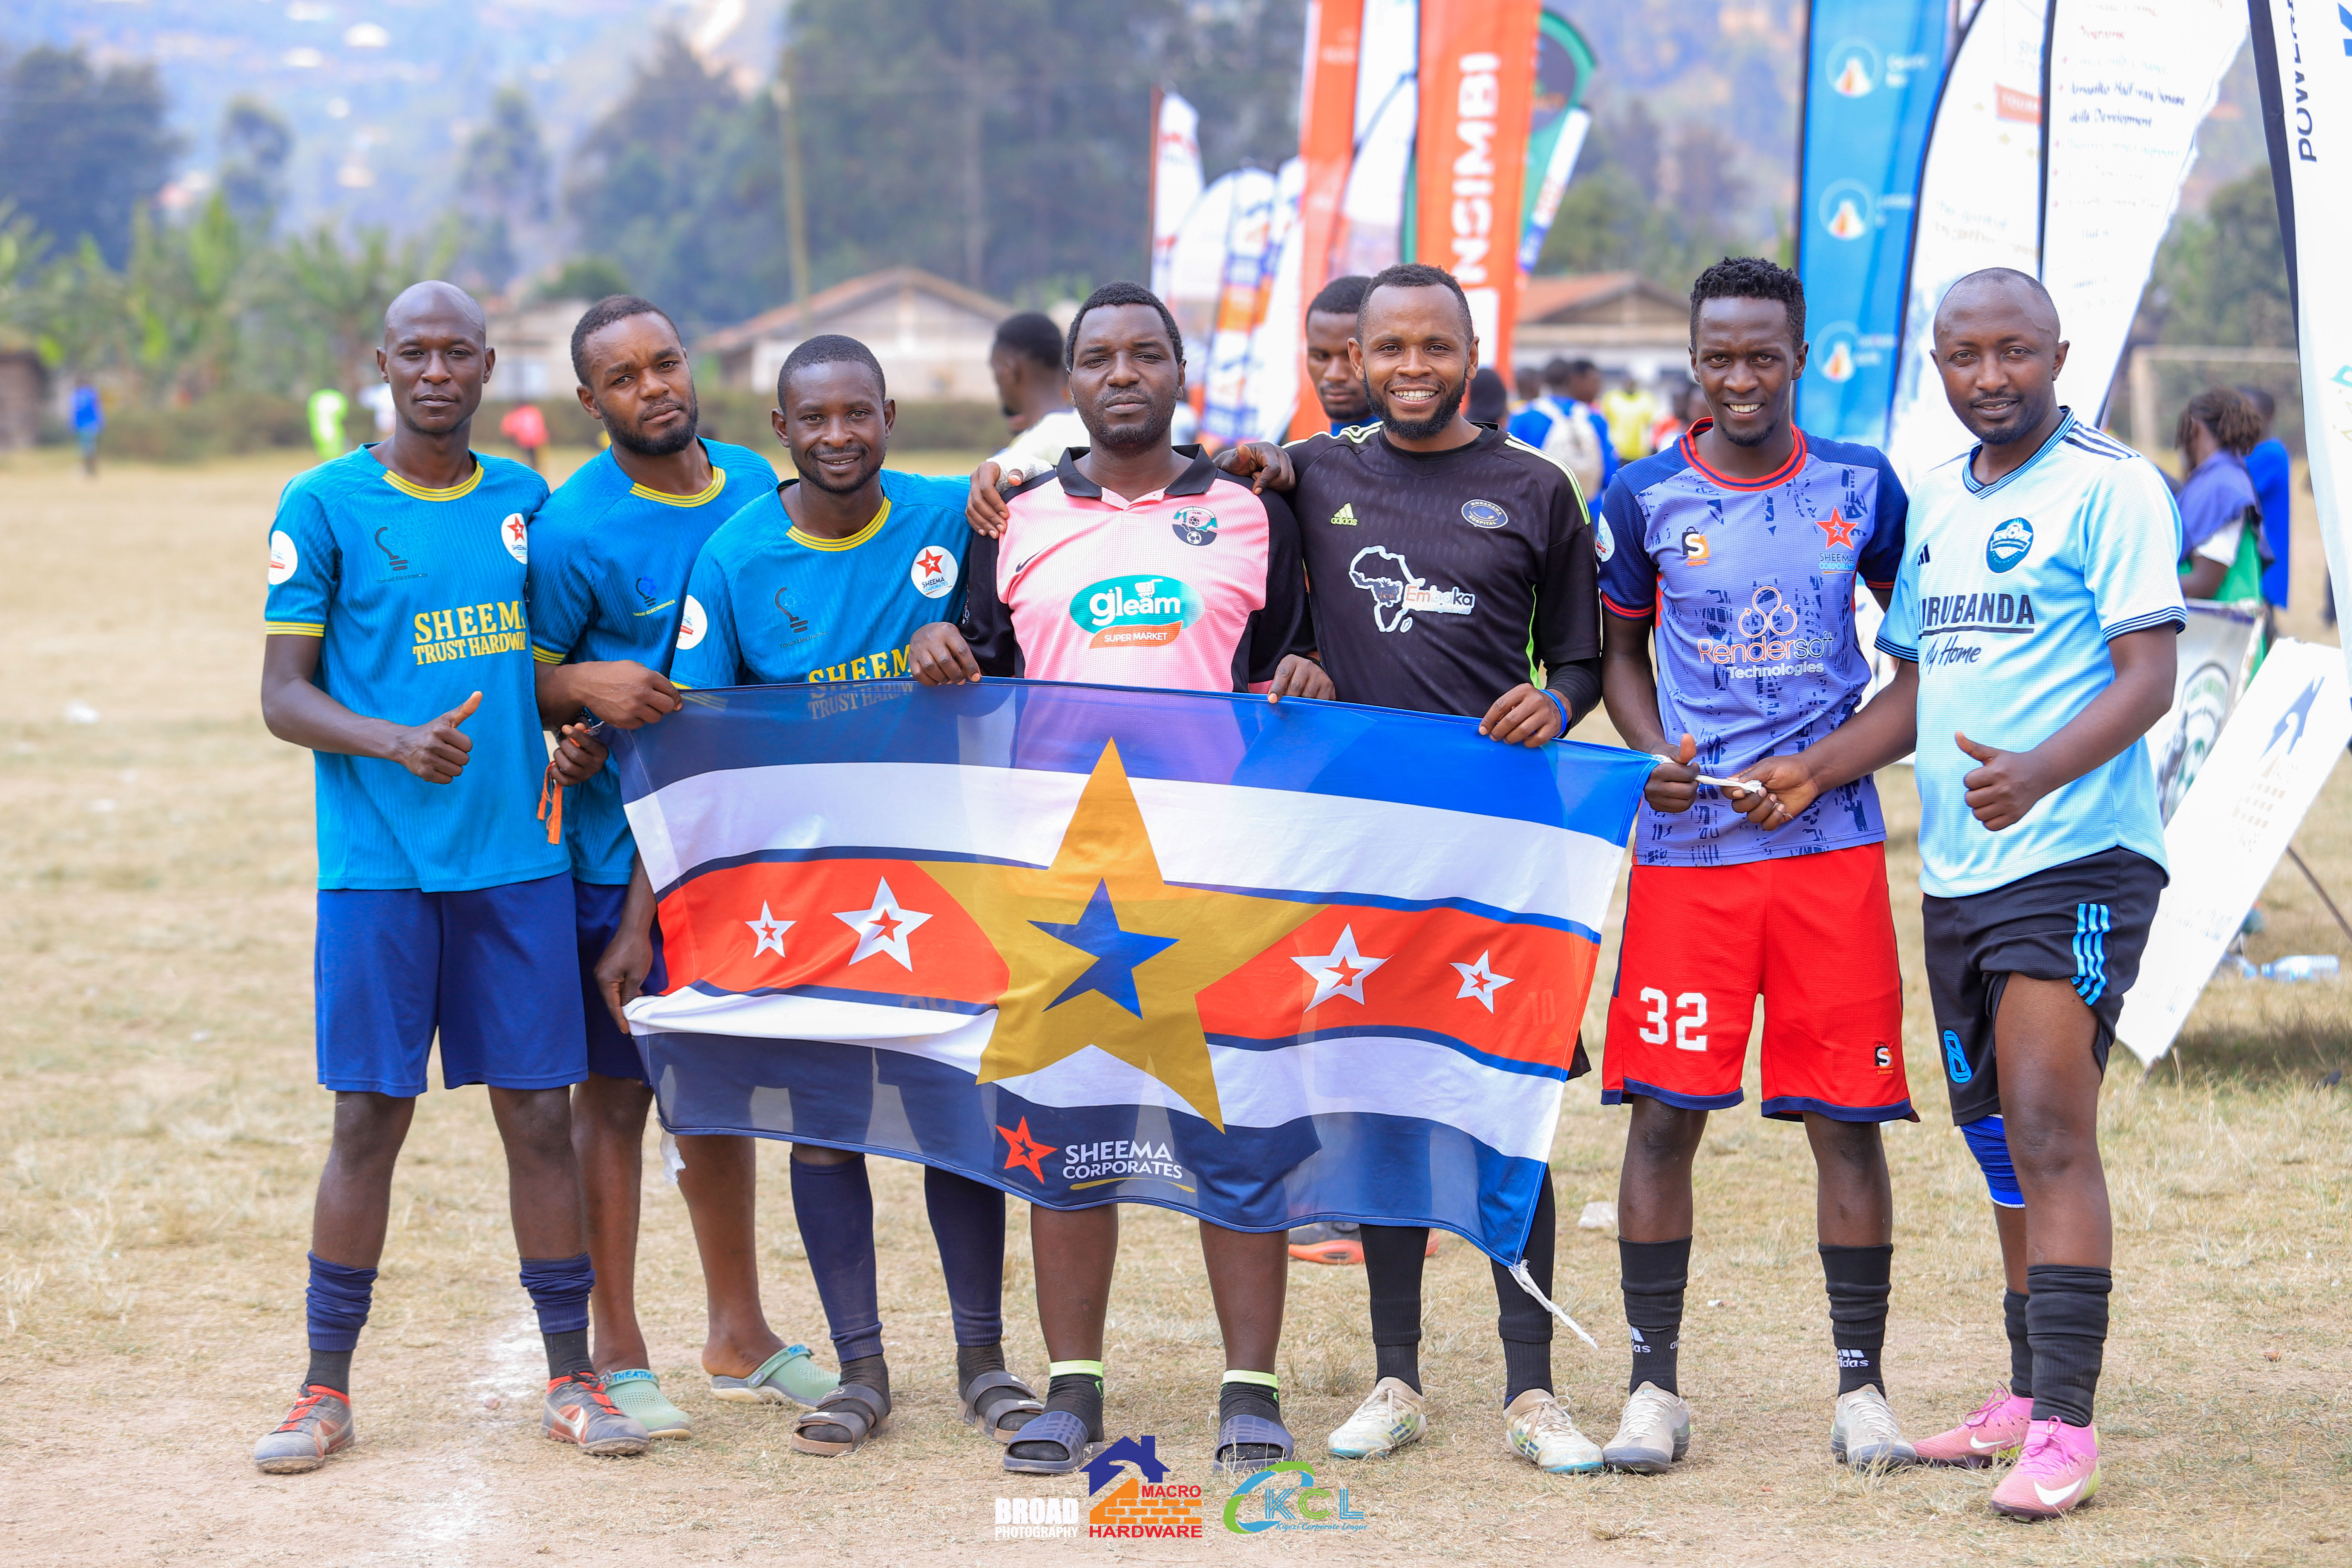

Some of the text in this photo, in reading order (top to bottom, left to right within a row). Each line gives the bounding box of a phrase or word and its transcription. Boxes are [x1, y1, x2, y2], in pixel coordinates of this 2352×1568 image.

[1471, 501, 1502, 515] RUGARAMA
[1331, 517, 1358, 526] adidas
[1468, 515, 1497, 525] HOSPITAL
[1819, 553, 1854, 562] SHEEMA
[396, 573, 428, 581] Electronics
[922, 576, 945, 588] SHEEMA
[922, 581, 949, 593] CORPORATES
[646, 599, 676, 615] ELECTRONICS
[1089, 586, 1181, 626] gleam
[779, 631, 828, 648] Tarud Electronics
[1104, 632, 1168, 643] SUPER MARKET
[413, 639, 467, 665] TRUST
[1697, 631, 1834, 664] Rendersoft
[1938, 634, 1981, 666] Home
[809, 644, 913, 698] SHEEM
[1727, 661, 1824, 679] Technologies
[1639, 986, 1708, 1051] 32
[1943, 1030, 1972, 1083] 8
[1065, 1139, 1173, 1164] SHEEMA
[1063, 1161, 1183, 1179] CORPORATES
[1838, 1356, 1870, 1368] idas
